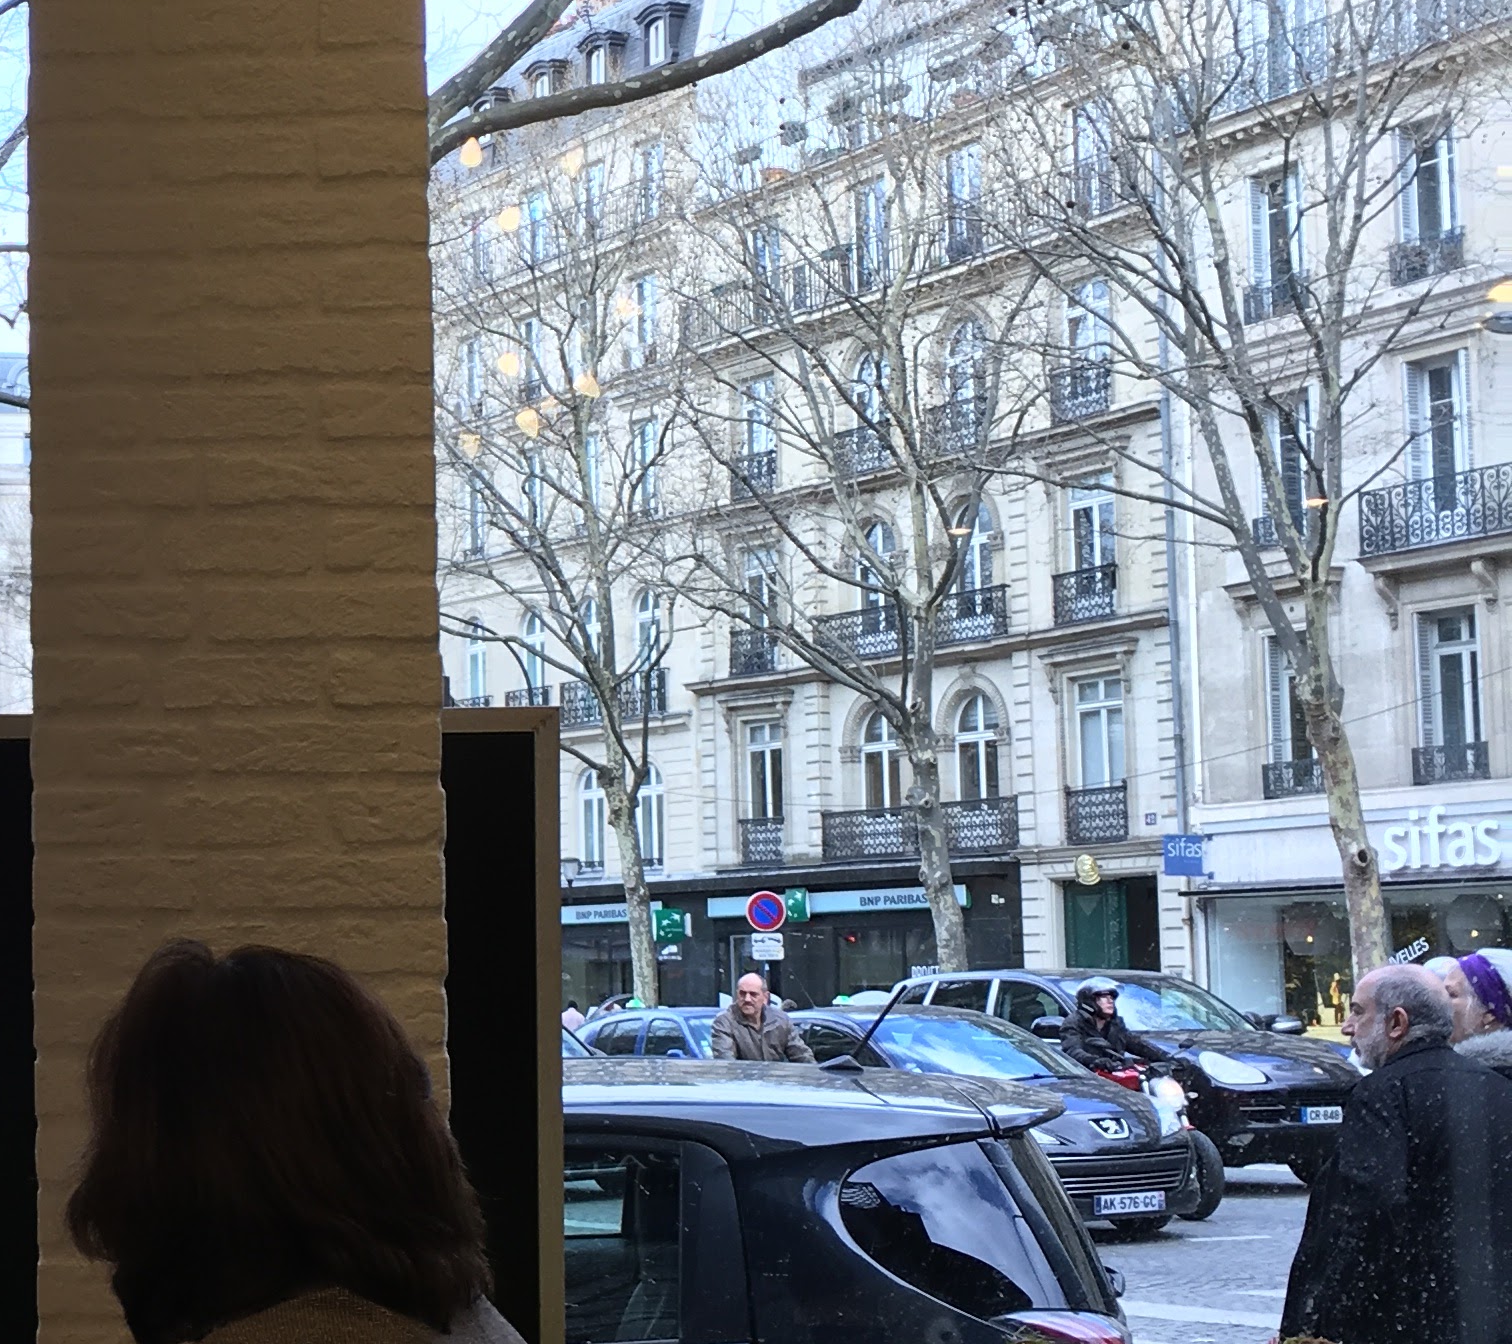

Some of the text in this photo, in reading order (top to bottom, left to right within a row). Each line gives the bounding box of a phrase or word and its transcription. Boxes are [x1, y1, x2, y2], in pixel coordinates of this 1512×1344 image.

[1168, 837, 1202, 857] sifas
[1384, 806, 1502, 871] sifas
[859, 893, 928, 907] BNP PARIBAS
[575, 908, 627, 920] BNP PARIBAS
[1389, 936, 1430, 964] VELLES
